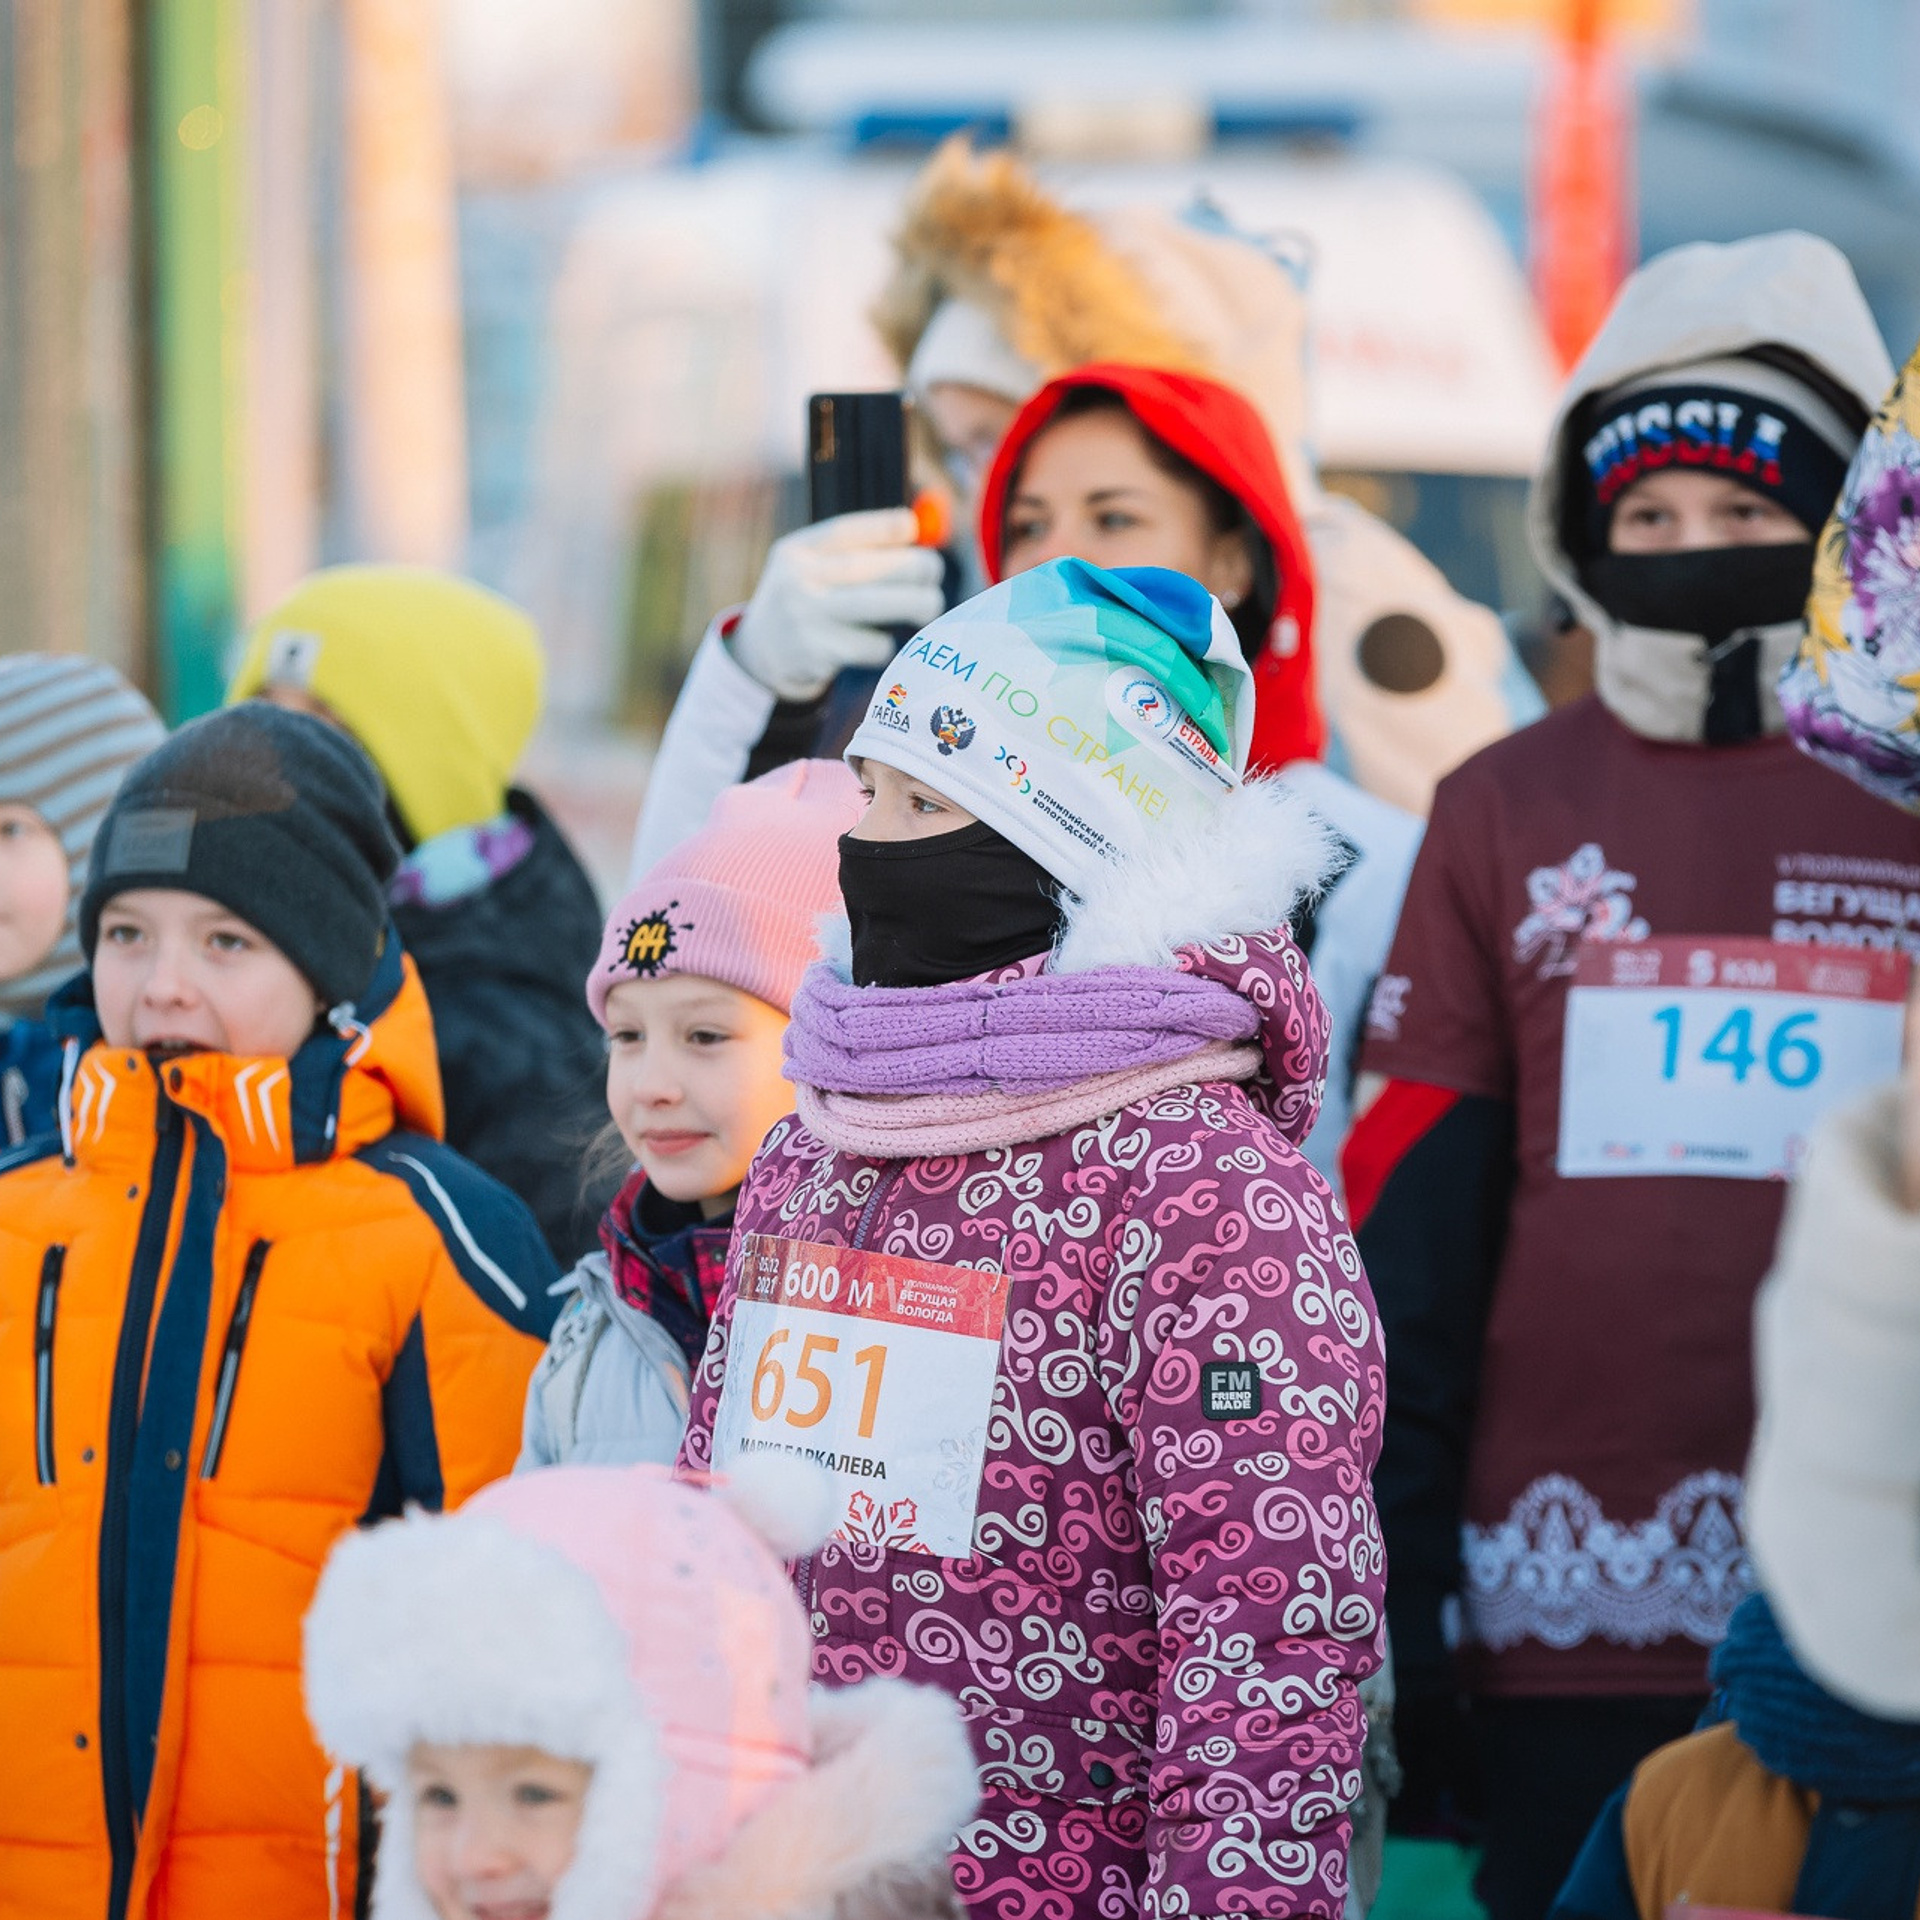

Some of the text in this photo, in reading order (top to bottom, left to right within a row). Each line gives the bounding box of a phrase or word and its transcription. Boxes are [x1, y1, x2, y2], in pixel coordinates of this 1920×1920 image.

[871, 705, 910, 729] TAFISA
[981, 671, 1039, 718] ПО
[1046, 715, 1170, 822] СТРАНЕ!
[1179, 724, 1219, 766] СТРАНА
[1688, 949, 1716, 987] 5
[1653, 1005, 1822, 1089] 146
[755, 1275, 779, 1294] 2021
[784, 1261, 874, 1309] 600 М
[900, 1289, 957, 1308] БЕГУЩАЯ
[896, 1303, 954, 1324] ВОЛОГДА
[751, 1328, 888, 1439] 651
[1211, 1370, 1252, 1391] FM
[1211, 1391, 1252, 1401] FRIEND
[1211, 1400, 1252, 1411] MADE
